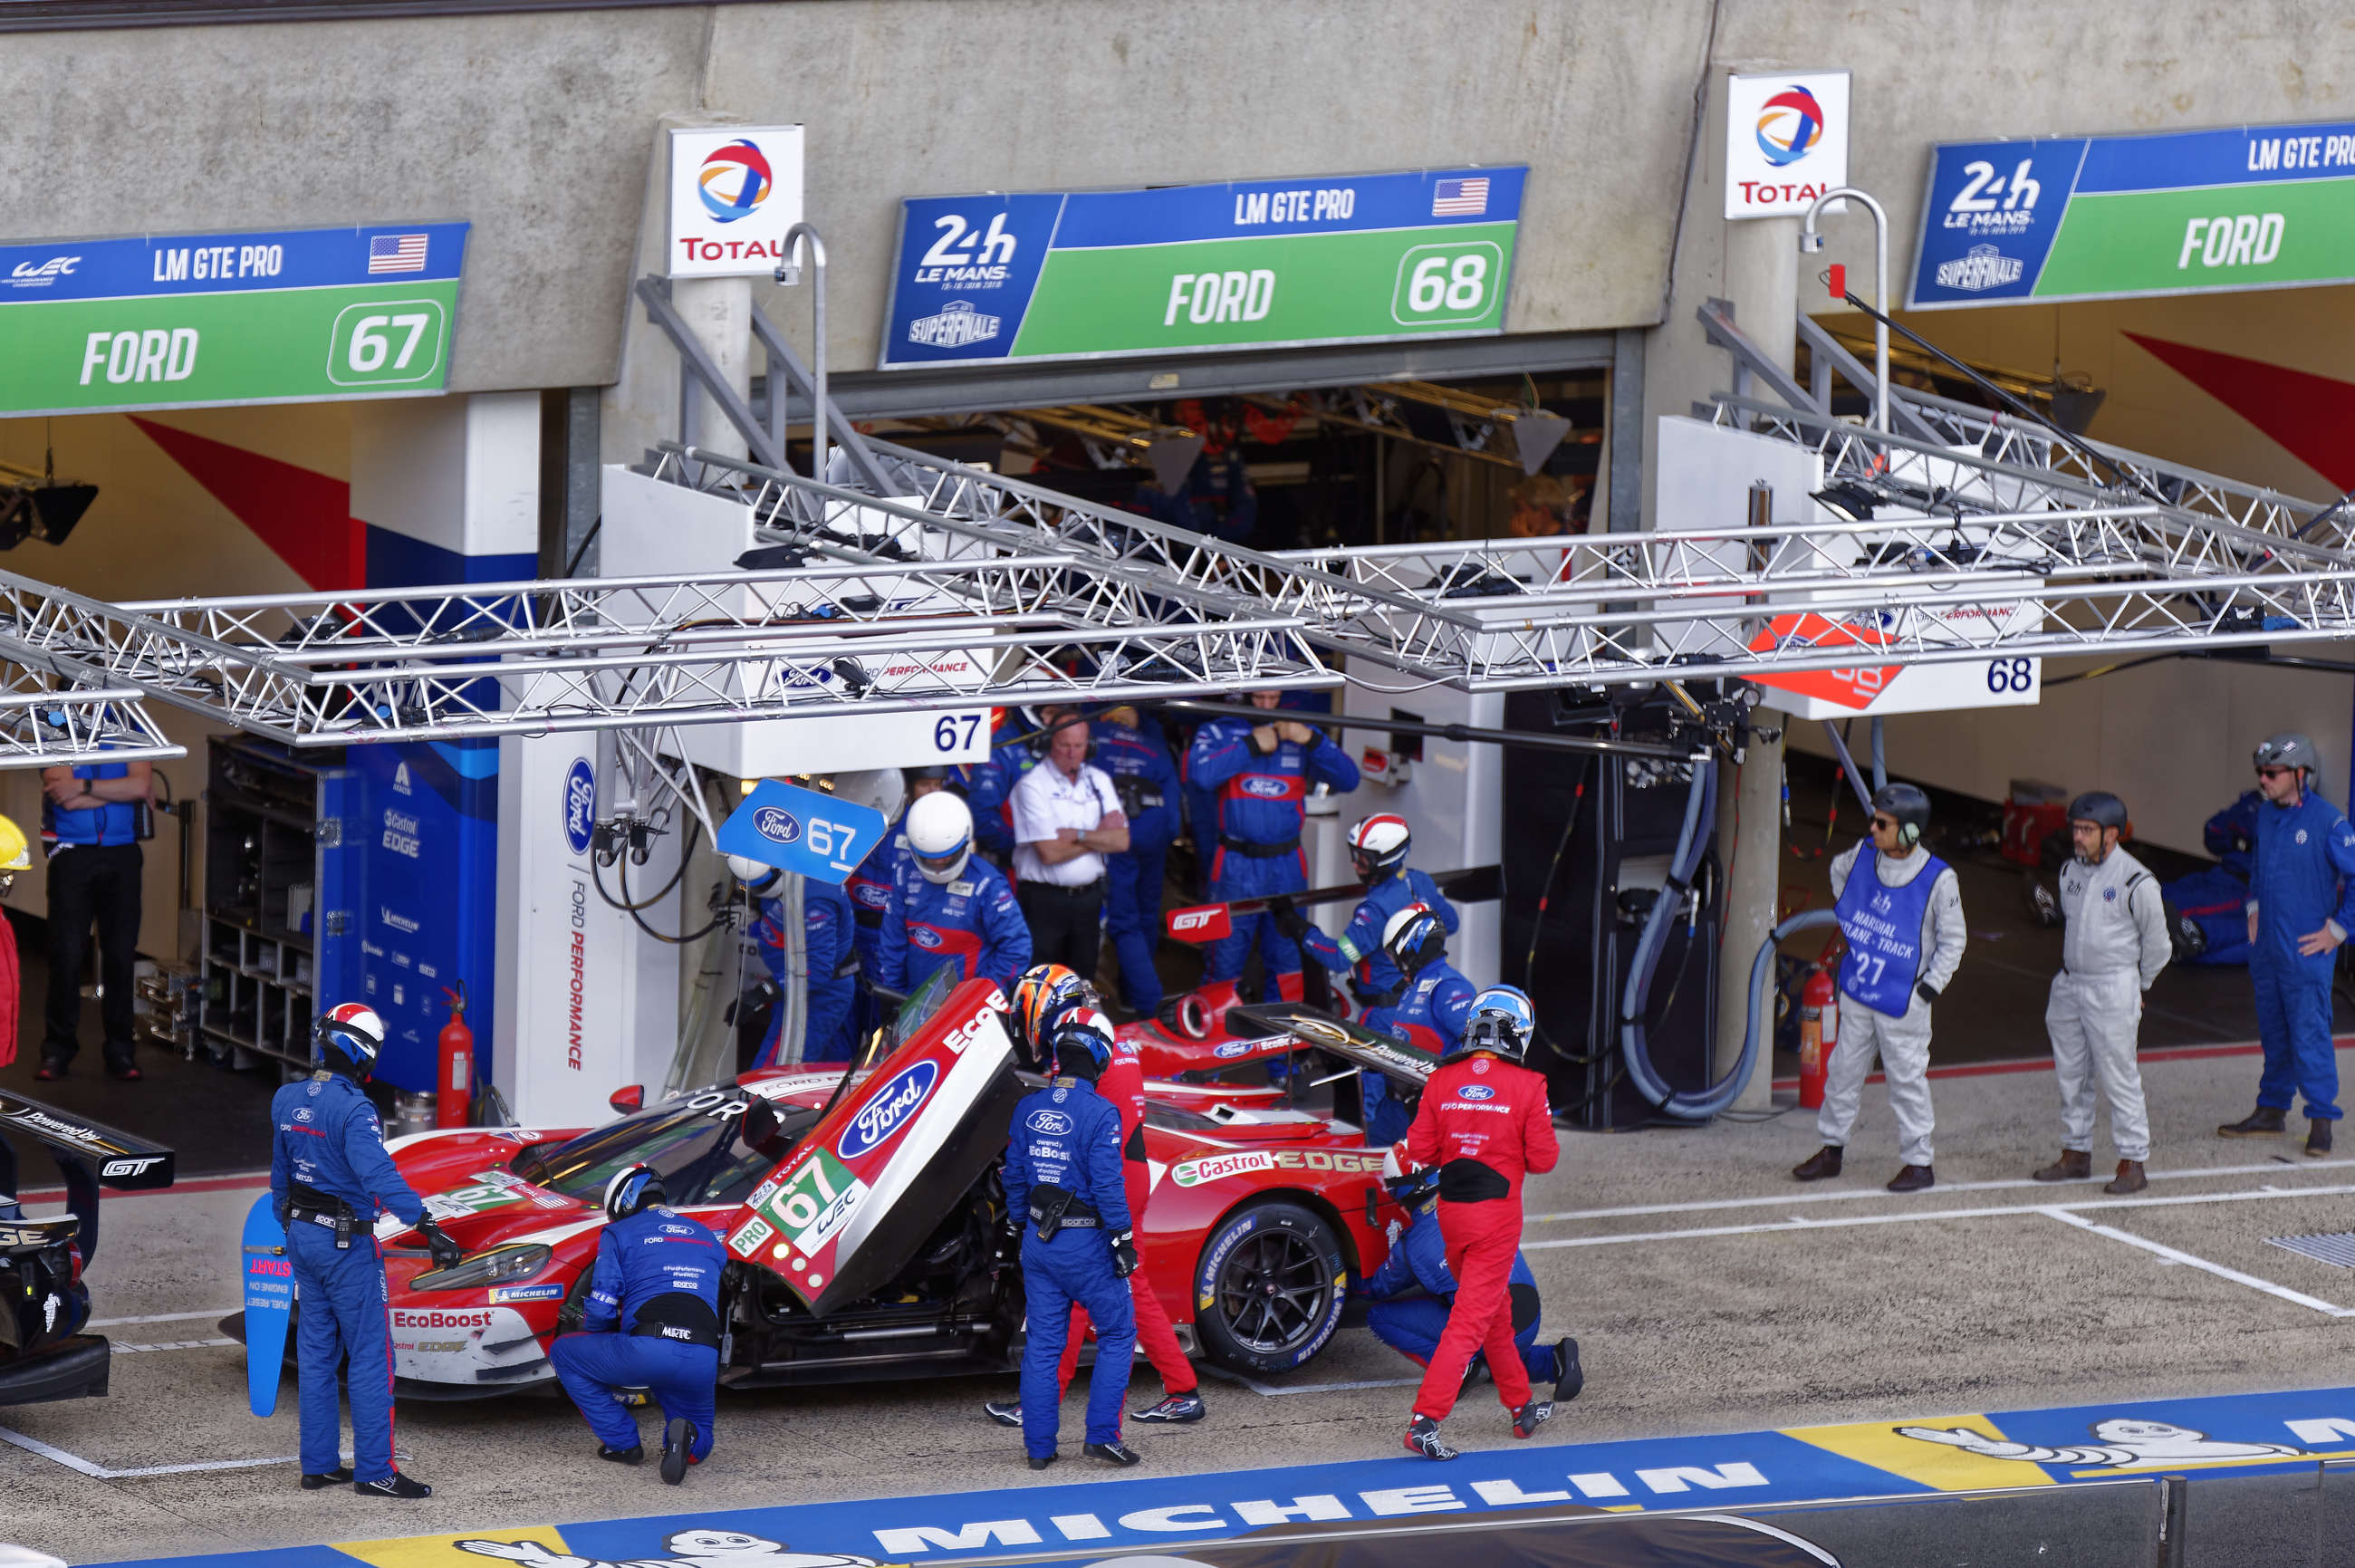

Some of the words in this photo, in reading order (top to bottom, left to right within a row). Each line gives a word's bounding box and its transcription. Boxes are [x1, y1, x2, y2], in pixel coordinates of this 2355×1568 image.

[2248, 139, 2279, 171] LM
[2283, 137, 2320, 169] GTE
[1949, 159, 2041, 213] 24h
[1235, 192, 1267, 225] LM
[1272, 190, 1309, 223] GTE
[1312, 188, 1354, 221] PRO
[1943, 213, 1971, 228] LE
[1971, 210, 2032, 226] MANS
[920, 213, 1016, 266] 24h
[2178, 213, 2285, 270] FORD
[12, 256, 82, 277] WEC
[153, 249, 183, 282] LM
[193, 246, 236, 279] GTE
[239, 245, 282, 278] PRO
[914, 268, 943, 283] LE
[943, 266, 1007, 282] MANS
[1937, 255, 2022, 290] SUPERFINALE
[1164, 268, 1276, 326] FORD
[1408, 254, 1487, 312] 68
[348, 313, 429, 371] 67
[910, 313, 998, 345] SUPERFINALE
[80, 328, 198, 386] FORD
[1986, 659, 2033, 693] 68
[934, 715, 982, 752] 67
[569, 775, 594, 837] Ford
[391, 813, 417, 835] Castrol
[762, 811, 793, 839] Ford
[807, 817, 856, 861] 67
[382, 830, 420, 859] EDGE
[571, 880, 586, 929] FORD
[1173, 909, 1224, 930] GT
[1853, 909, 1897, 938] MARSHAL
[1878, 937, 1914, 959] TRACK
[567, 930, 585, 1072] PERFORMANCE
[25, 1112, 84, 1138] Powered
[82, 1130, 101, 1141] by
[858, 1076, 921, 1144] Ford
[101, 1158, 166, 1177] GT
[773, 1145, 814, 1180] TOTAL
[1197, 1153, 1268, 1178] Castrol
[1275, 1151, 1384, 1172] EDGE
[771, 1156, 837, 1228] 67
[818, 1188, 855, 1235] WEC
[1061, 1217, 1095, 1226] sparco
[733, 1220, 768, 1254] PRO
[1206, 1220, 1253, 1282] MICHELIN
[249, 1258, 293, 1277] START
[246, 1297, 270, 1308] RESET
[248, 1282, 260, 1290] ON
[261, 1283, 289, 1294] ENGINE
[511, 1289, 558, 1298] MICHELIN
[394, 1311, 492, 1328] EcoBoost
[1297, 1302, 1342, 1363] MICHELIN
[393, 1342, 415, 1351] astrol
[418, 1341, 467, 1353] EDGE
[872, 1462, 1770, 1554] MICHELIN
